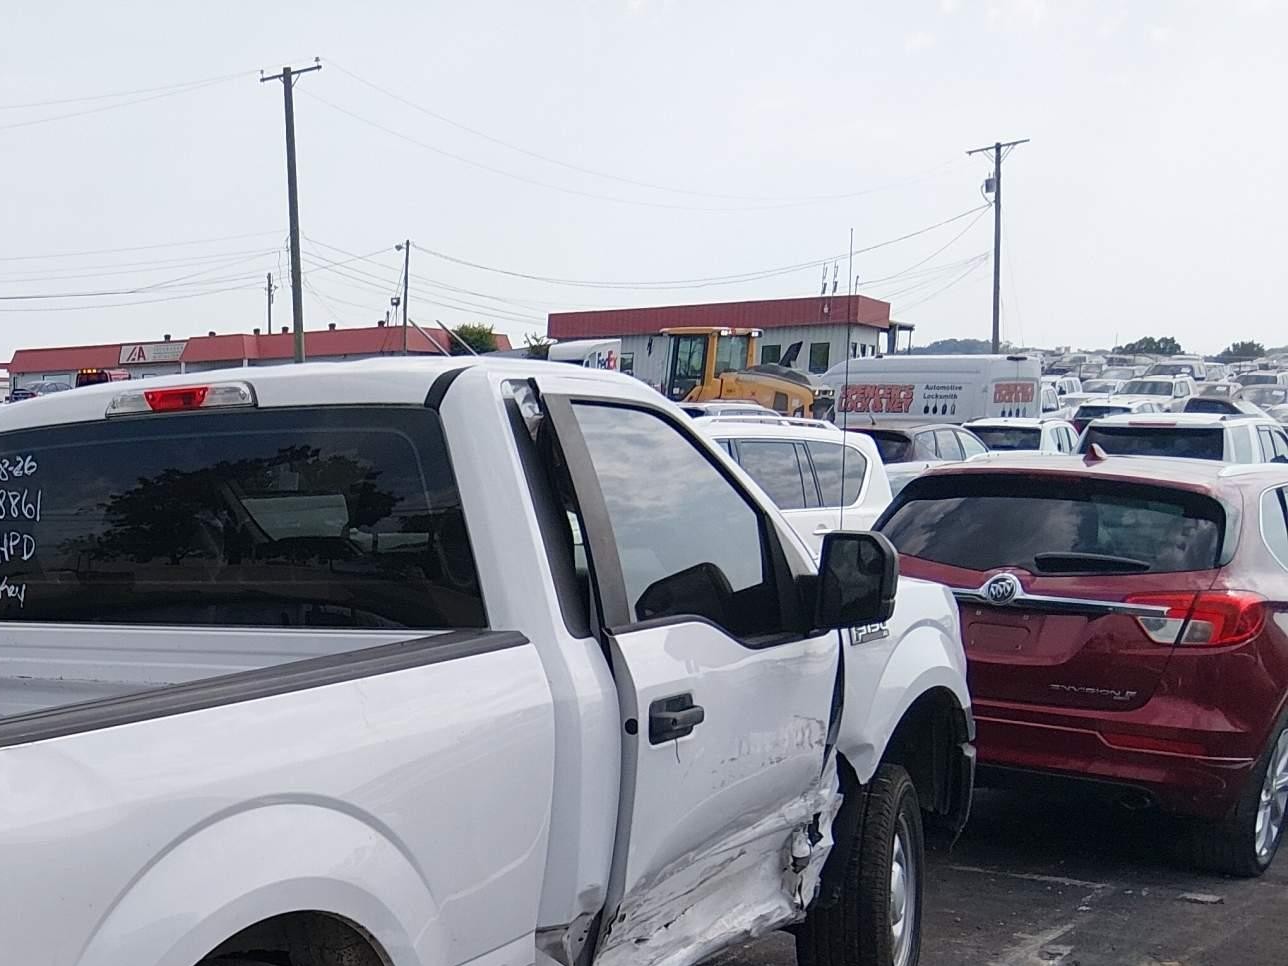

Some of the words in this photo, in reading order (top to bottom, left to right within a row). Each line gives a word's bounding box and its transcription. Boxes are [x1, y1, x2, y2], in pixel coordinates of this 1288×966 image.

[923, 392, 958, 400] Locksmith
[837, 397, 870, 413] LOCK
[885, 397, 913, 413] KEY
